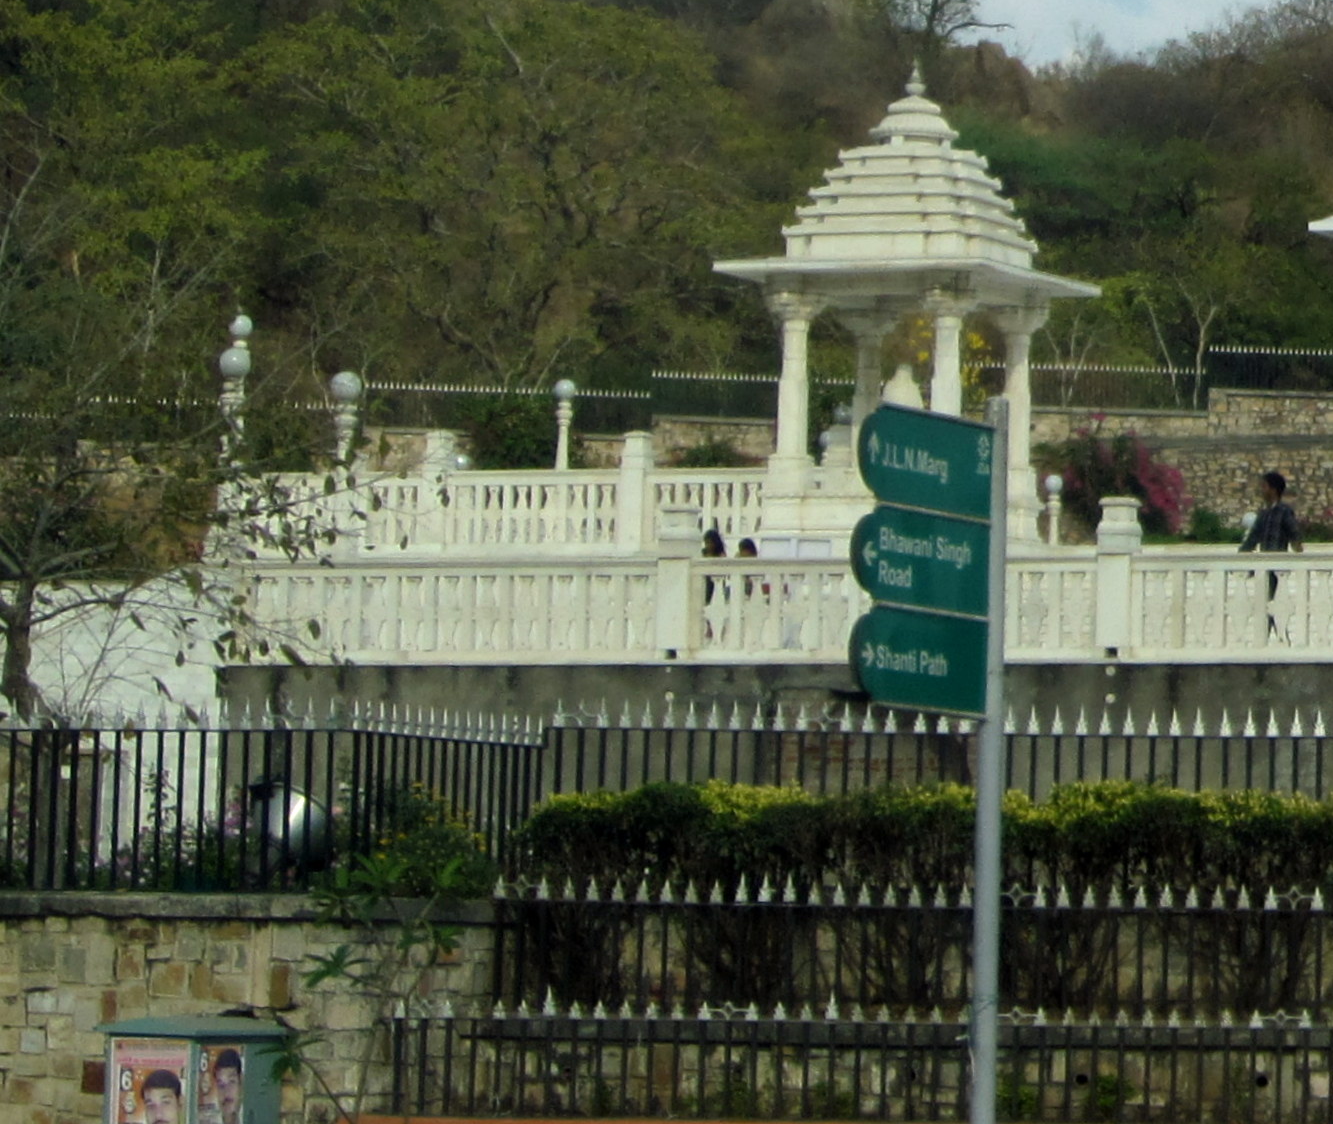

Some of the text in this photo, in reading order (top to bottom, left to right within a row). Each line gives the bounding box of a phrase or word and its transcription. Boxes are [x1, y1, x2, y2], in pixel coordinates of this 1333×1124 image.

[879, 527, 971, 569] Bhawani Singh
[878, 561, 912, 588] Road
[876, 645, 948, 675] Shanti Path
